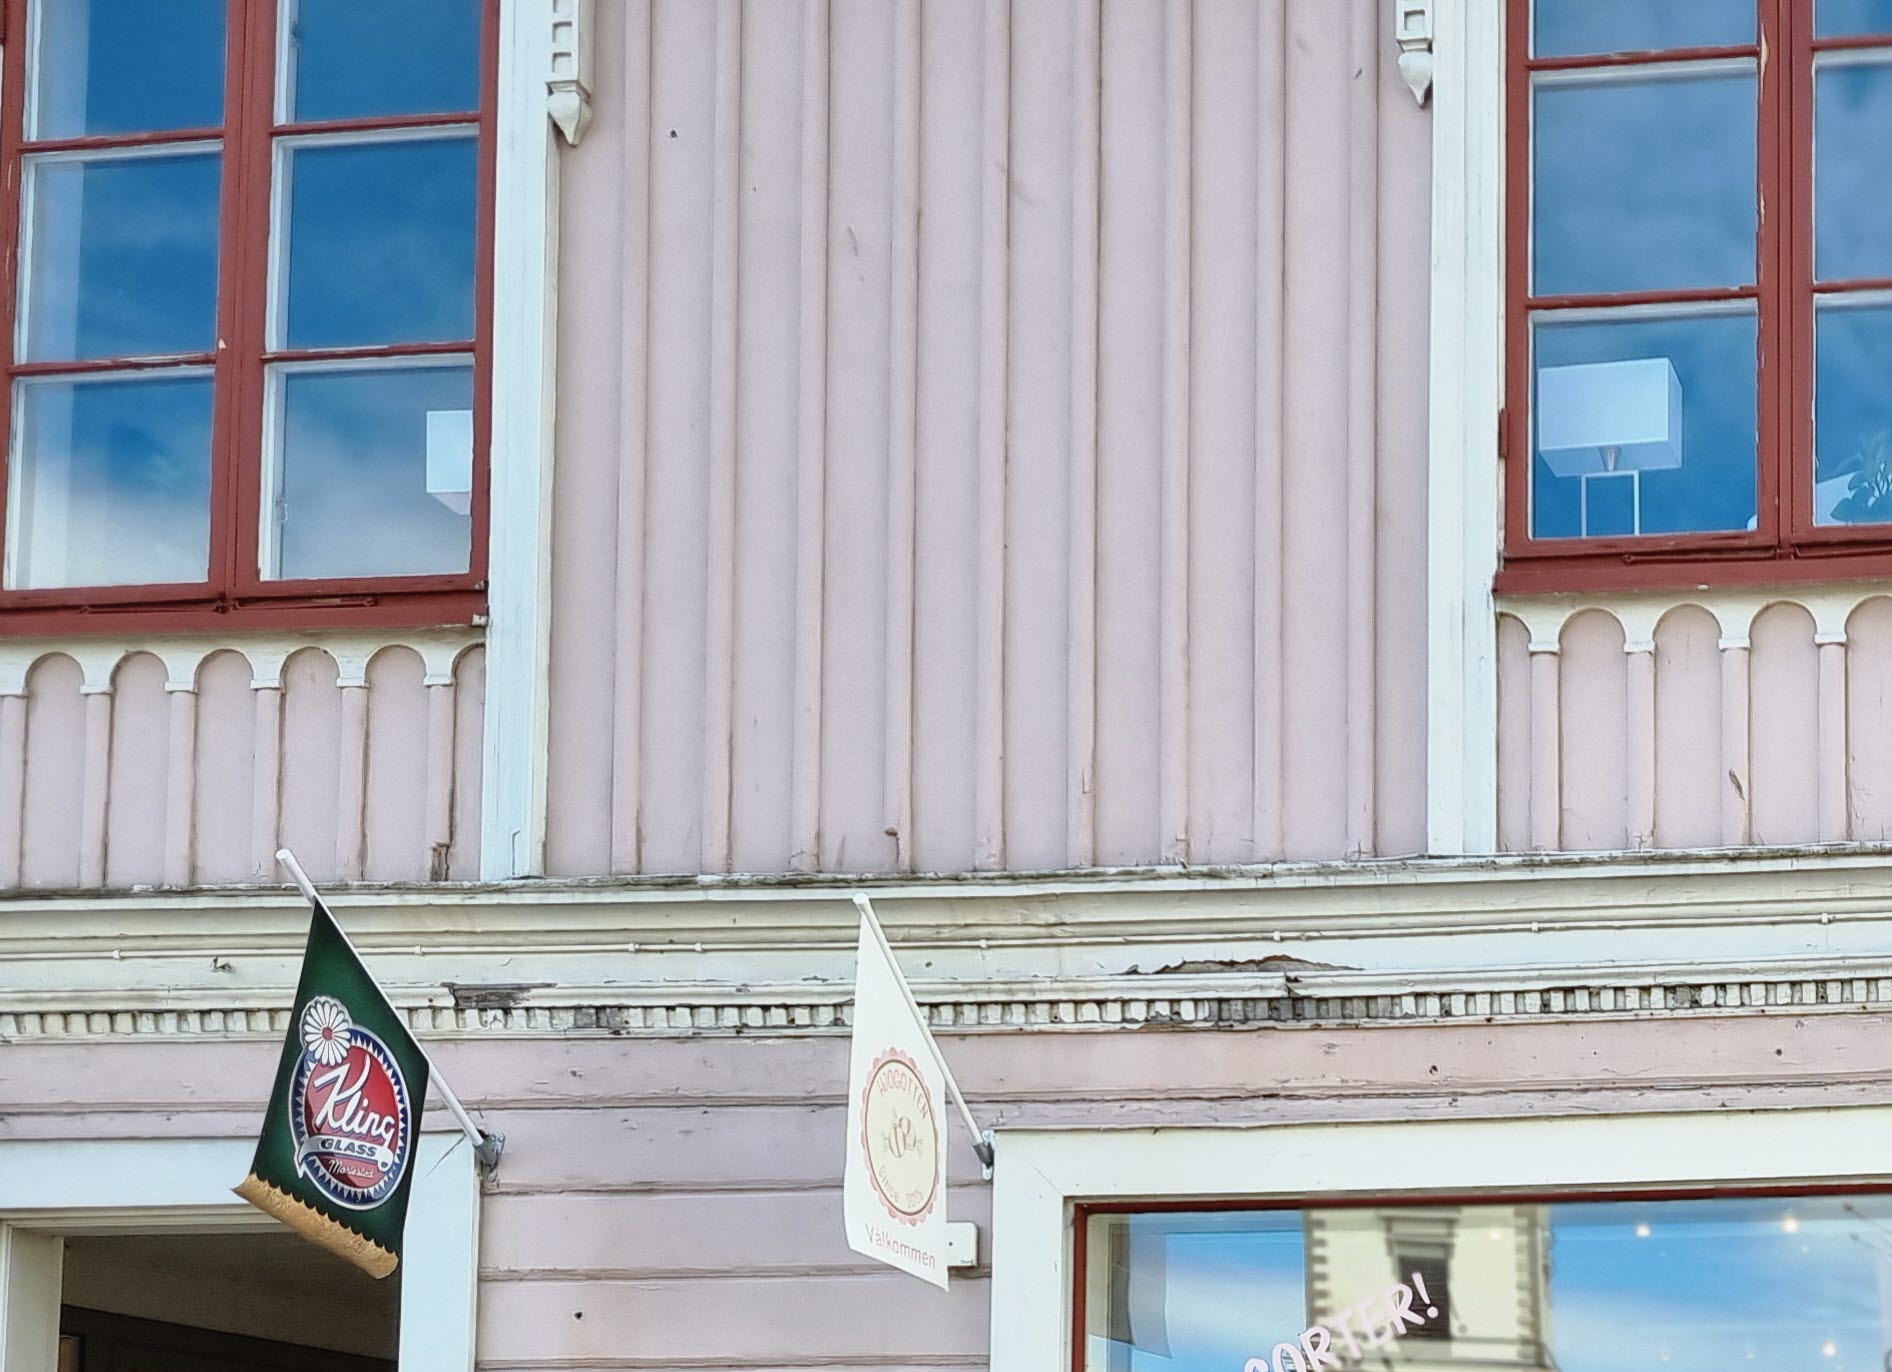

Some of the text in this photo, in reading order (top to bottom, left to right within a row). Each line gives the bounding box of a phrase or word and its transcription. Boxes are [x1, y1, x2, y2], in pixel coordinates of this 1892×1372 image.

[313, 1053, 395, 1147] Kling
[320, 1137, 377, 1157] GLASS
[878, 1165, 900, 1205] Since
[865, 1223, 936, 1269] Välkommen
